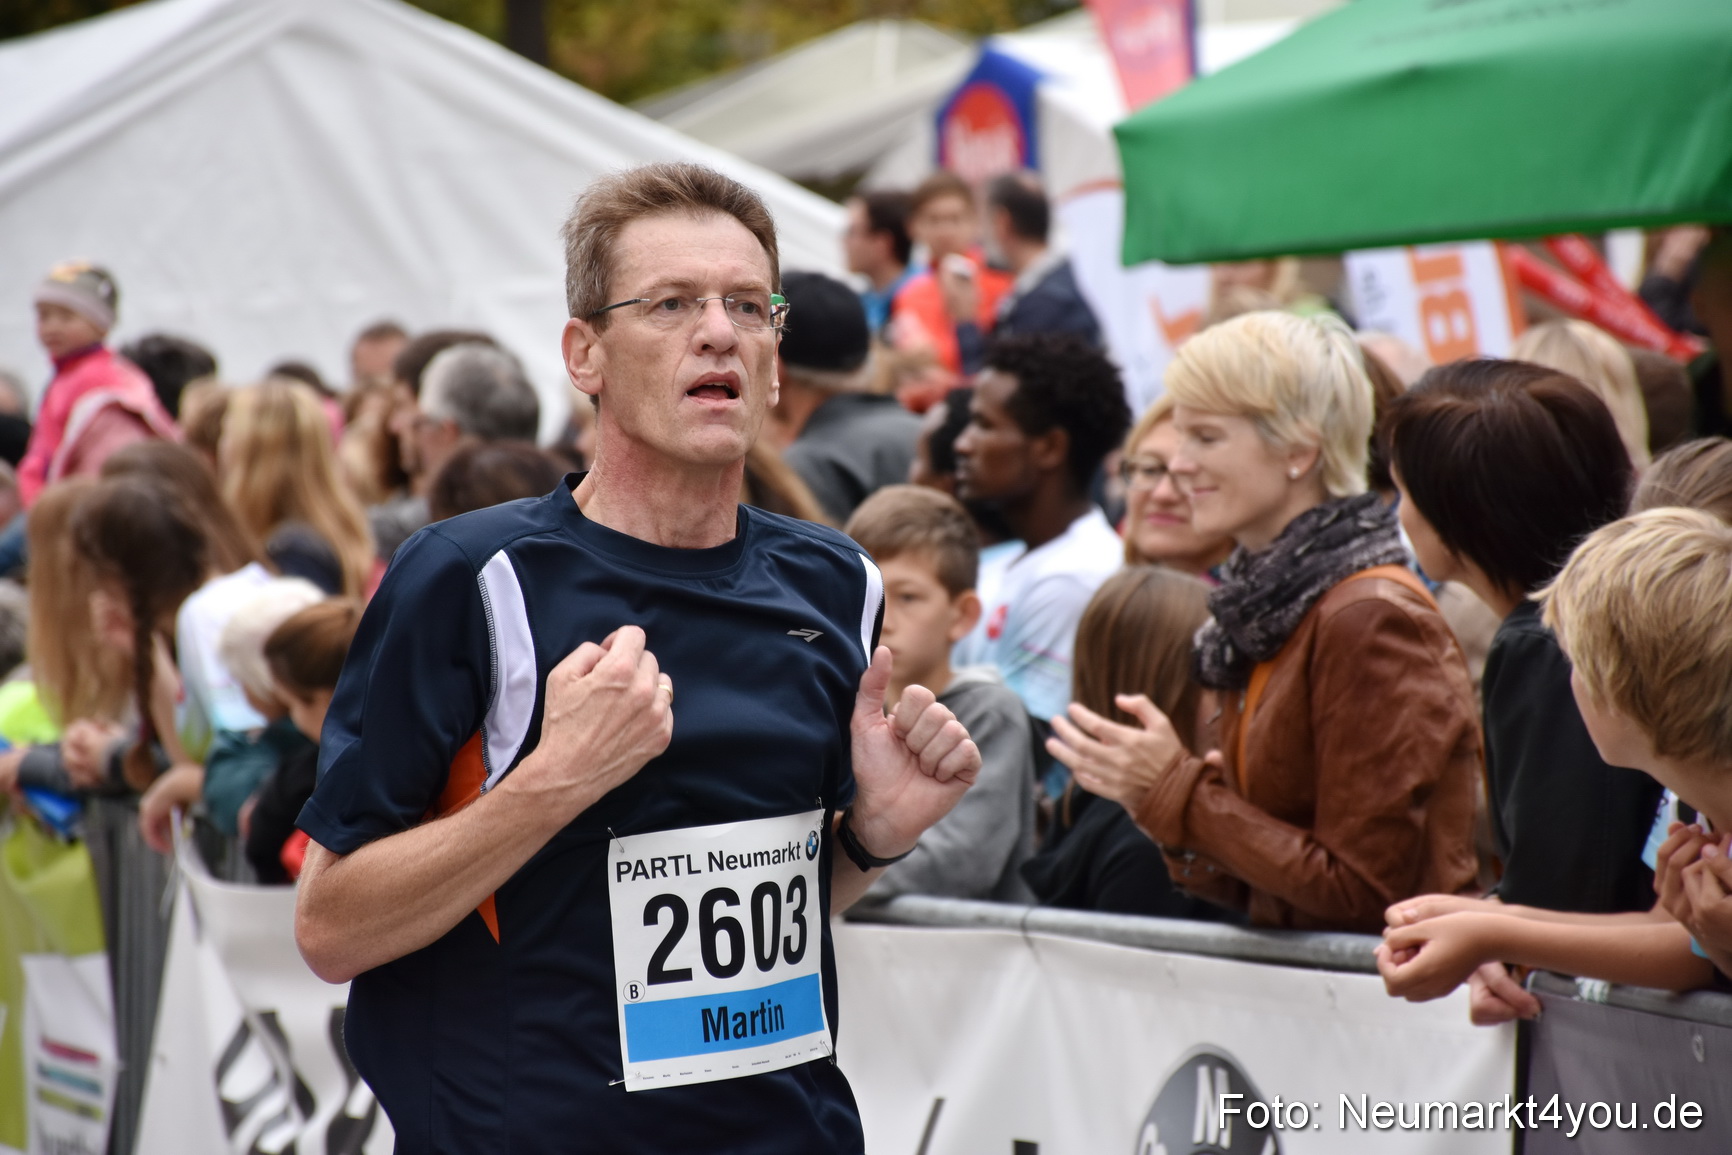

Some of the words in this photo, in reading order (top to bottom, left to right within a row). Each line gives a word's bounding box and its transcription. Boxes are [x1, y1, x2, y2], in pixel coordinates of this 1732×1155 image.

[616, 853, 701, 883] PARTL
[707, 841, 801, 873] Neumarkt
[642, 874, 808, 986] 2603
[629, 984, 639, 1000] B
[701, 999, 785, 1043] Martin
